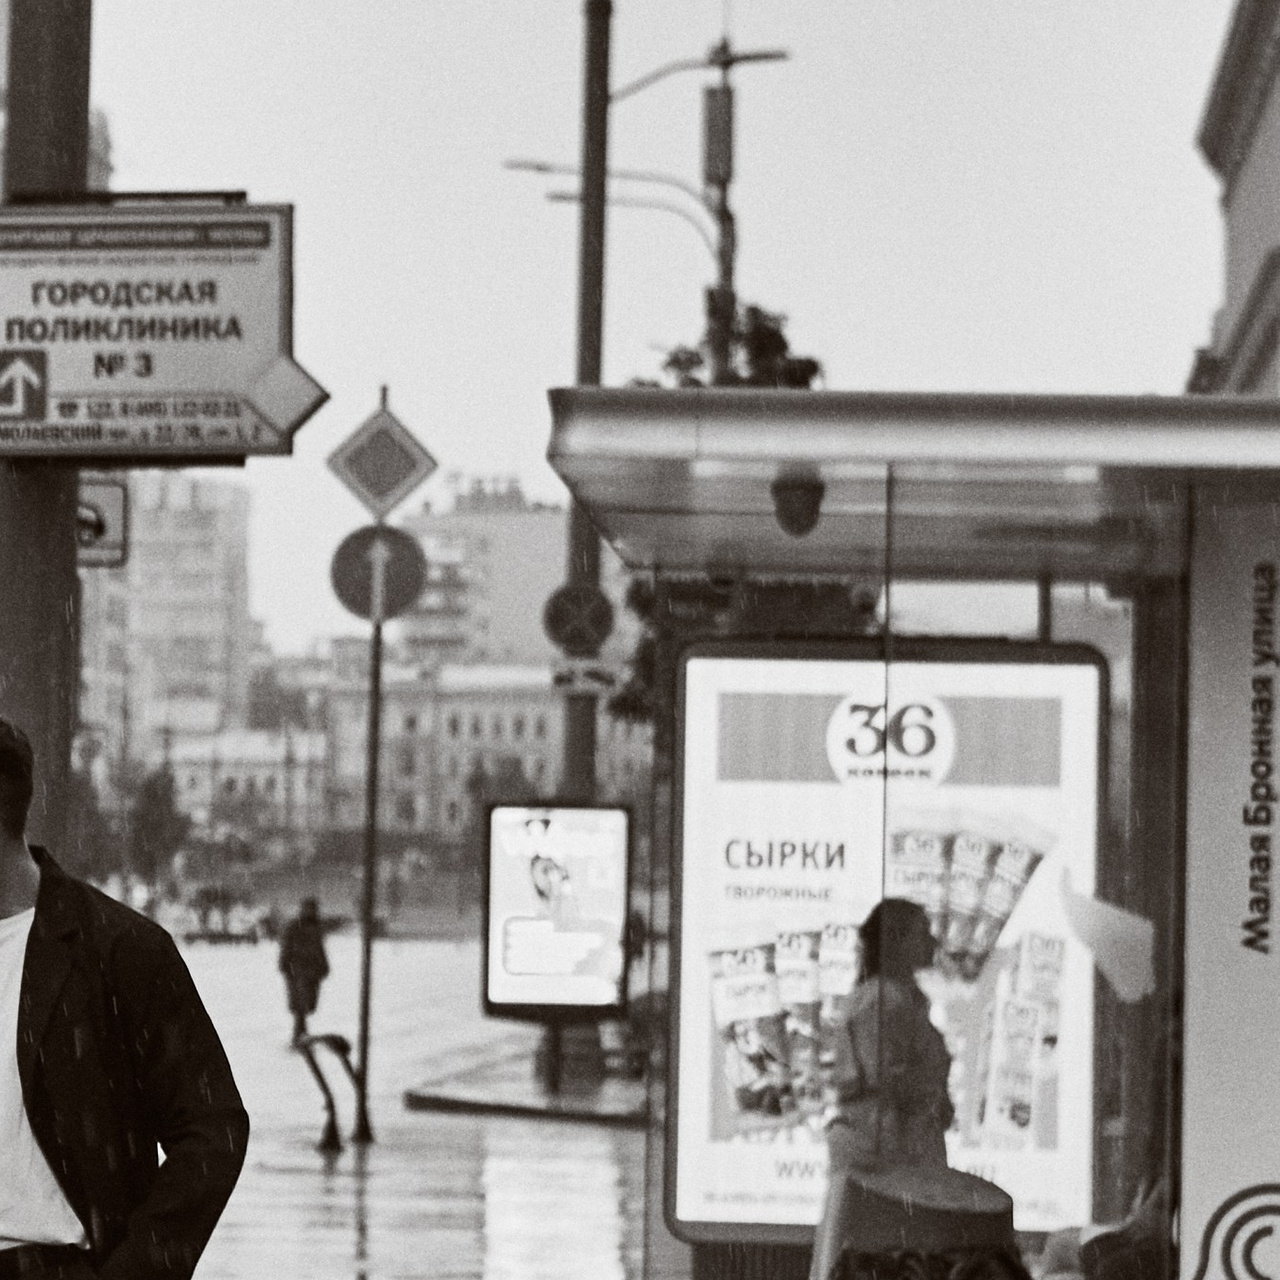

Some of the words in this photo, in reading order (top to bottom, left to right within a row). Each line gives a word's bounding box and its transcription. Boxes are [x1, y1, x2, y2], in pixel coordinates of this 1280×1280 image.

[31, 281, 217, 309] ГОРОДСКАЯ
[5, 317, 243, 343] ПОЛИКЛИНИКА
[94, 353, 125, 378] №
[134, 353, 153, 377] 3
[1252, 562, 1279, 667] улица
[846, 704, 936, 757] 36
[1242, 677, 1278, 827] Бронная
[725, 839, 845, 870] СЫРКИ
[1240, 834, 1272, 955] Малая
